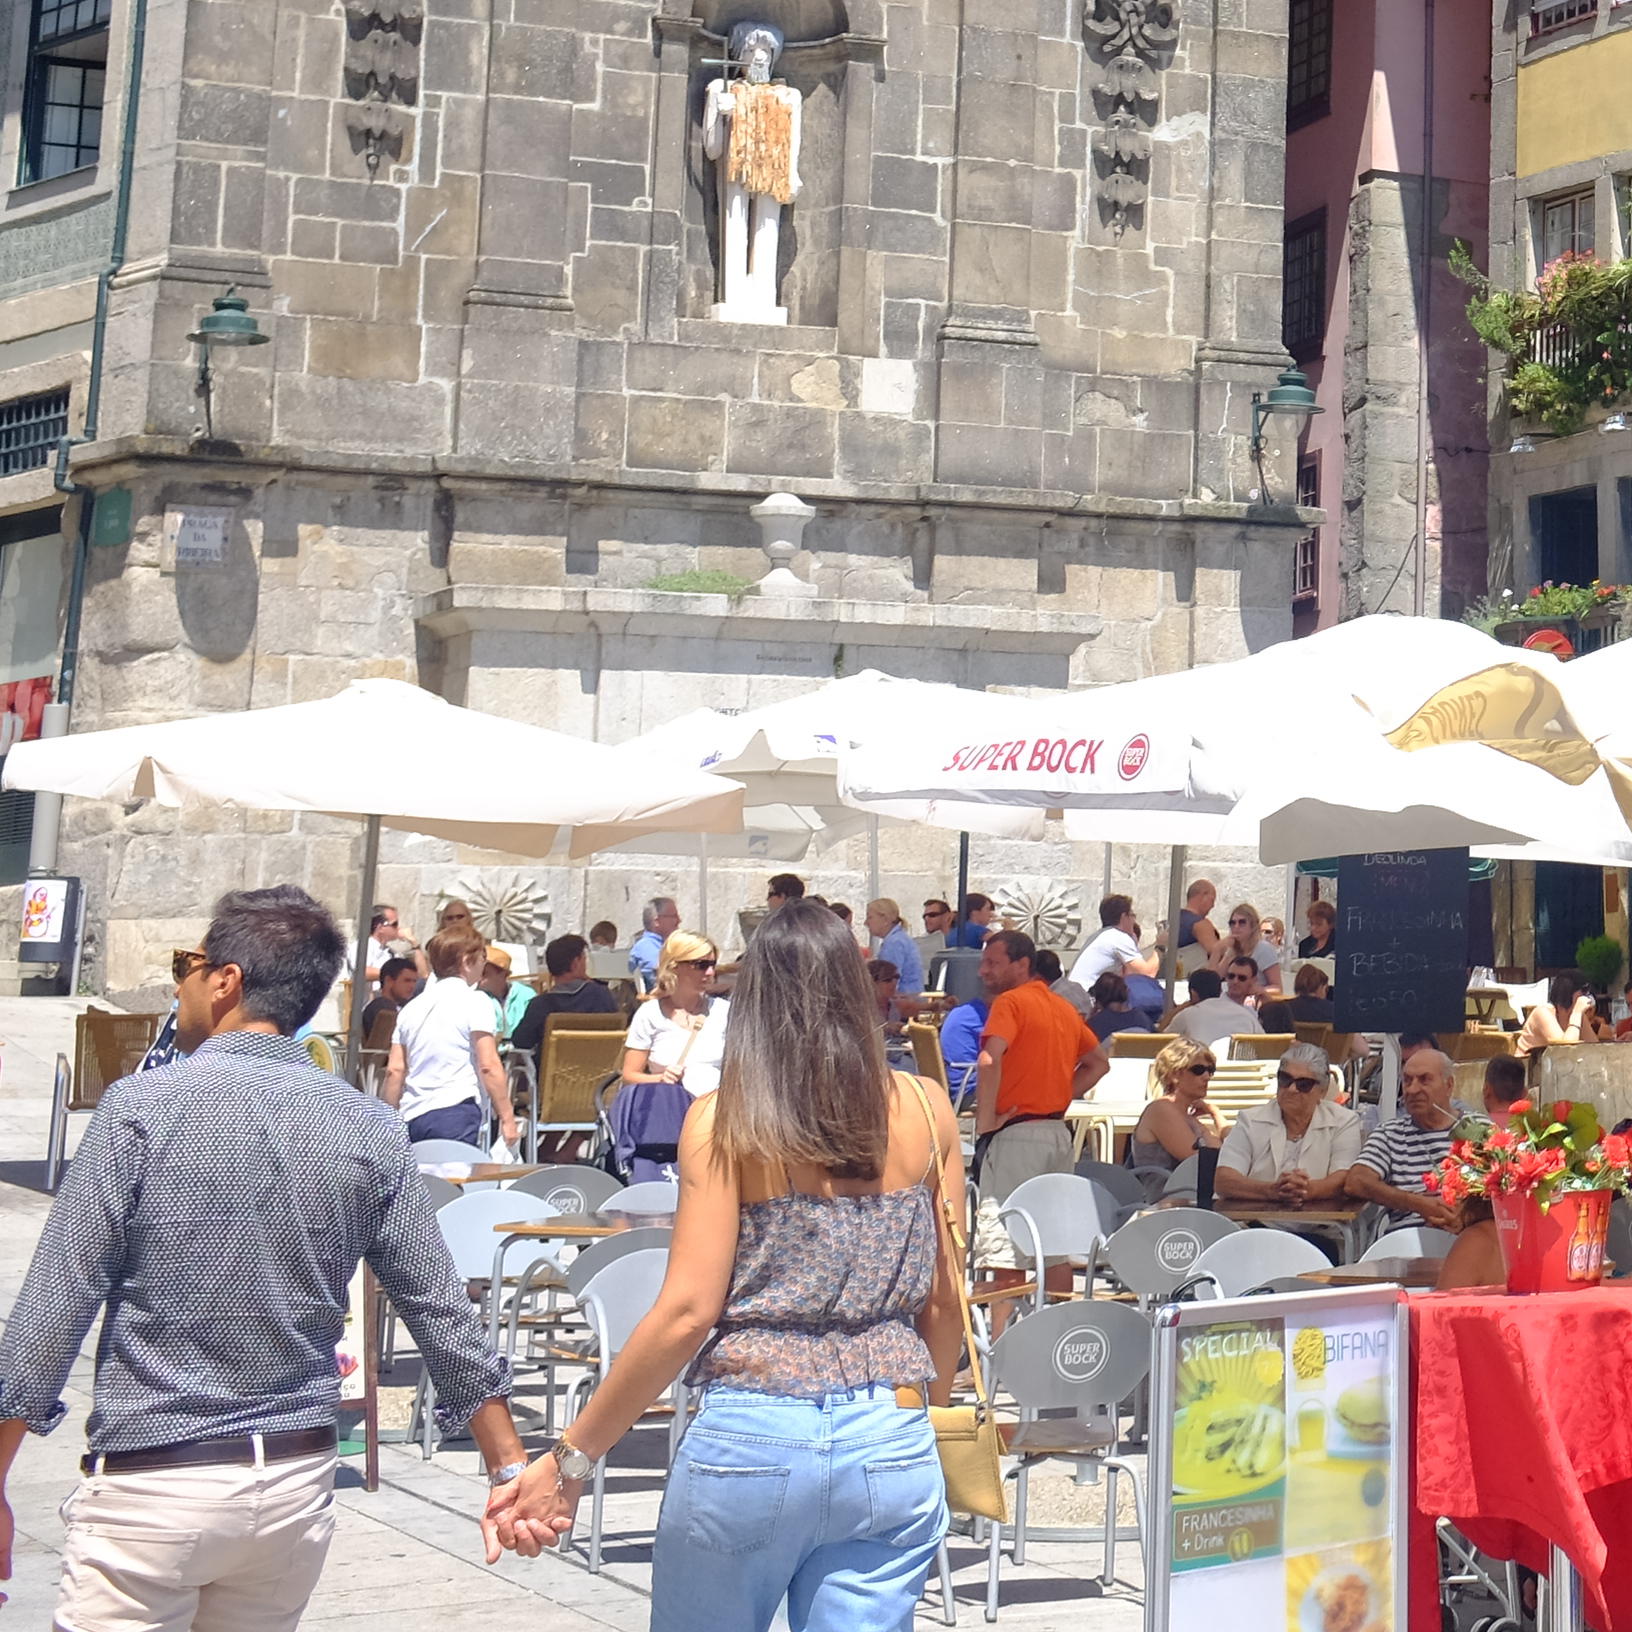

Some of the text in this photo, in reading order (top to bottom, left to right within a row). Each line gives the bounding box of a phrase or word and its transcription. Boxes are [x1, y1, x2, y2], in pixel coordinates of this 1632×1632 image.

[942, 738, 1104, 775] SUPER BOCK
[1163, 1242, 1194, 1252] SUPER
[1165, 1250, 1193, 1260] BOCK
[1064, 1343, 1100, 1354] SUPER
[1181, 1328, 1281, 1363] SPECIAL
[1323, 1329, 1389, 1364] BIFANA
[1064, 1353, 1097, 1365] BOCK
[1181, 1503, 1275, 1533] FRANCESINHA
[1194, 1533, 1225, 1552] Drink
